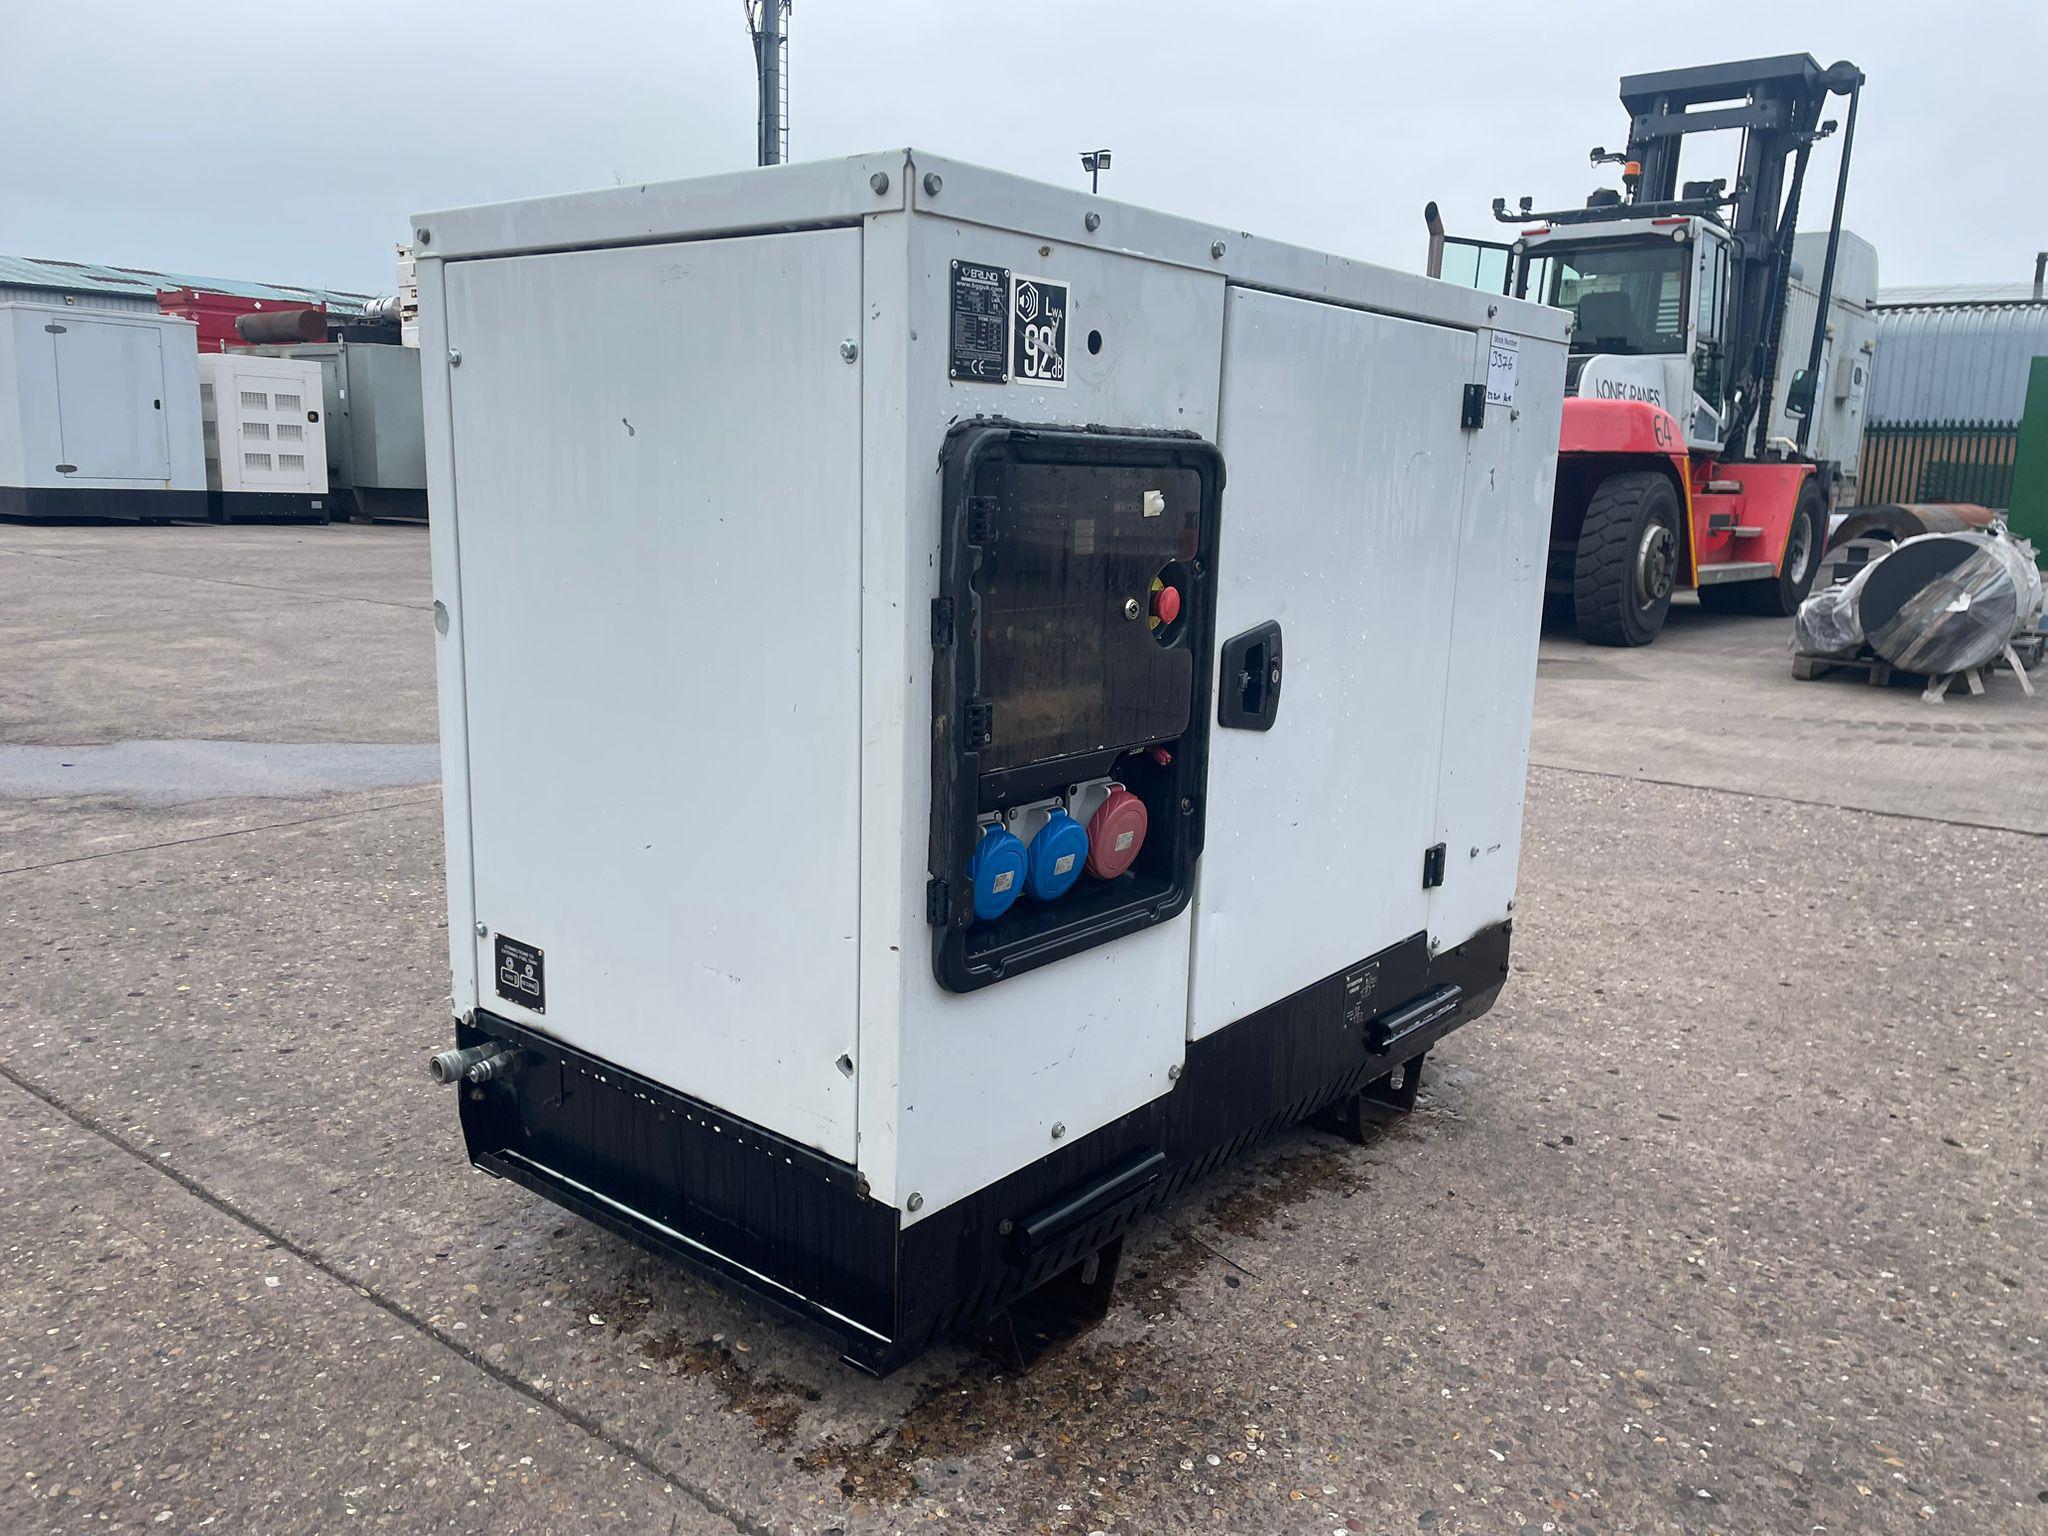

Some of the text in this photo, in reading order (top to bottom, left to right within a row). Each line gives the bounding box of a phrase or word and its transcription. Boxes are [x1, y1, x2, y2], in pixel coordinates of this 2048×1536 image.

[971, 268, 998, 281] BRUNO
[1491, 350, 1513, 371] 3376
[1653, 414, 1673, 448] 64
